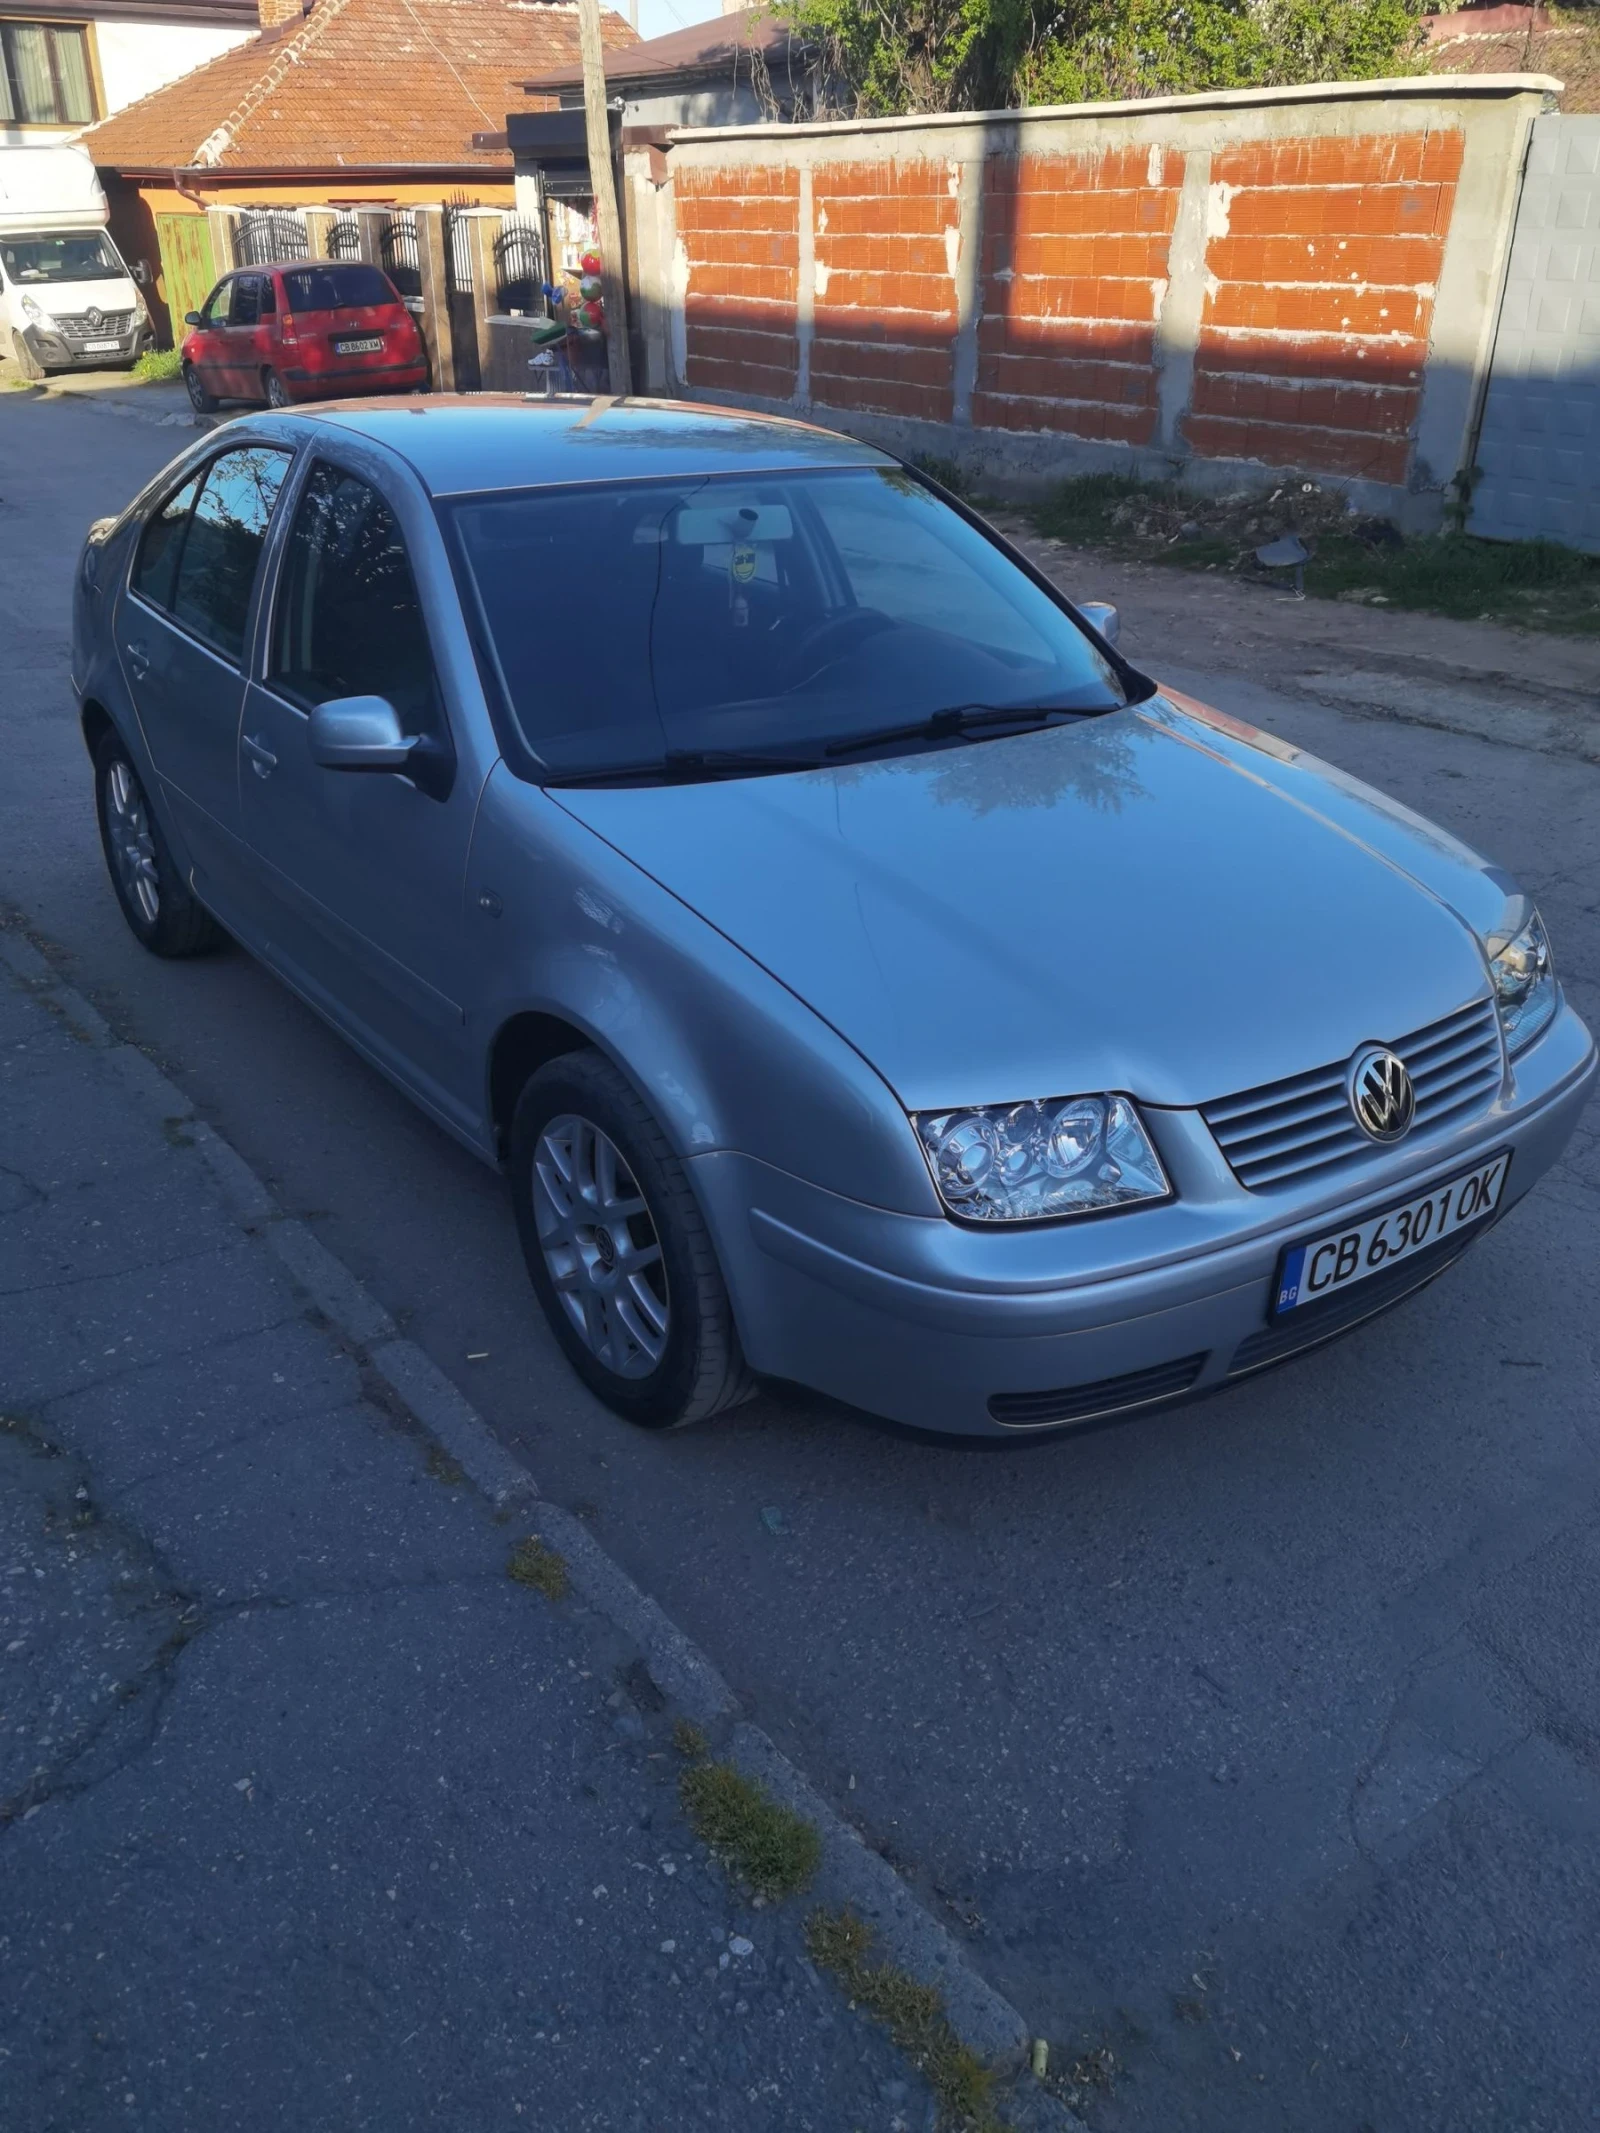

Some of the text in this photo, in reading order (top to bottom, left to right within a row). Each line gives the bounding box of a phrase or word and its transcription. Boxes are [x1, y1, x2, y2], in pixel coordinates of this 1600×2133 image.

[340, 343, 350, 352] CB
[1356, 1053, 1412, 1133] VW
[1308, 1162, 1502, 1293] CB 6301 OK
[1279, 1286, 1298, 1305] BG
